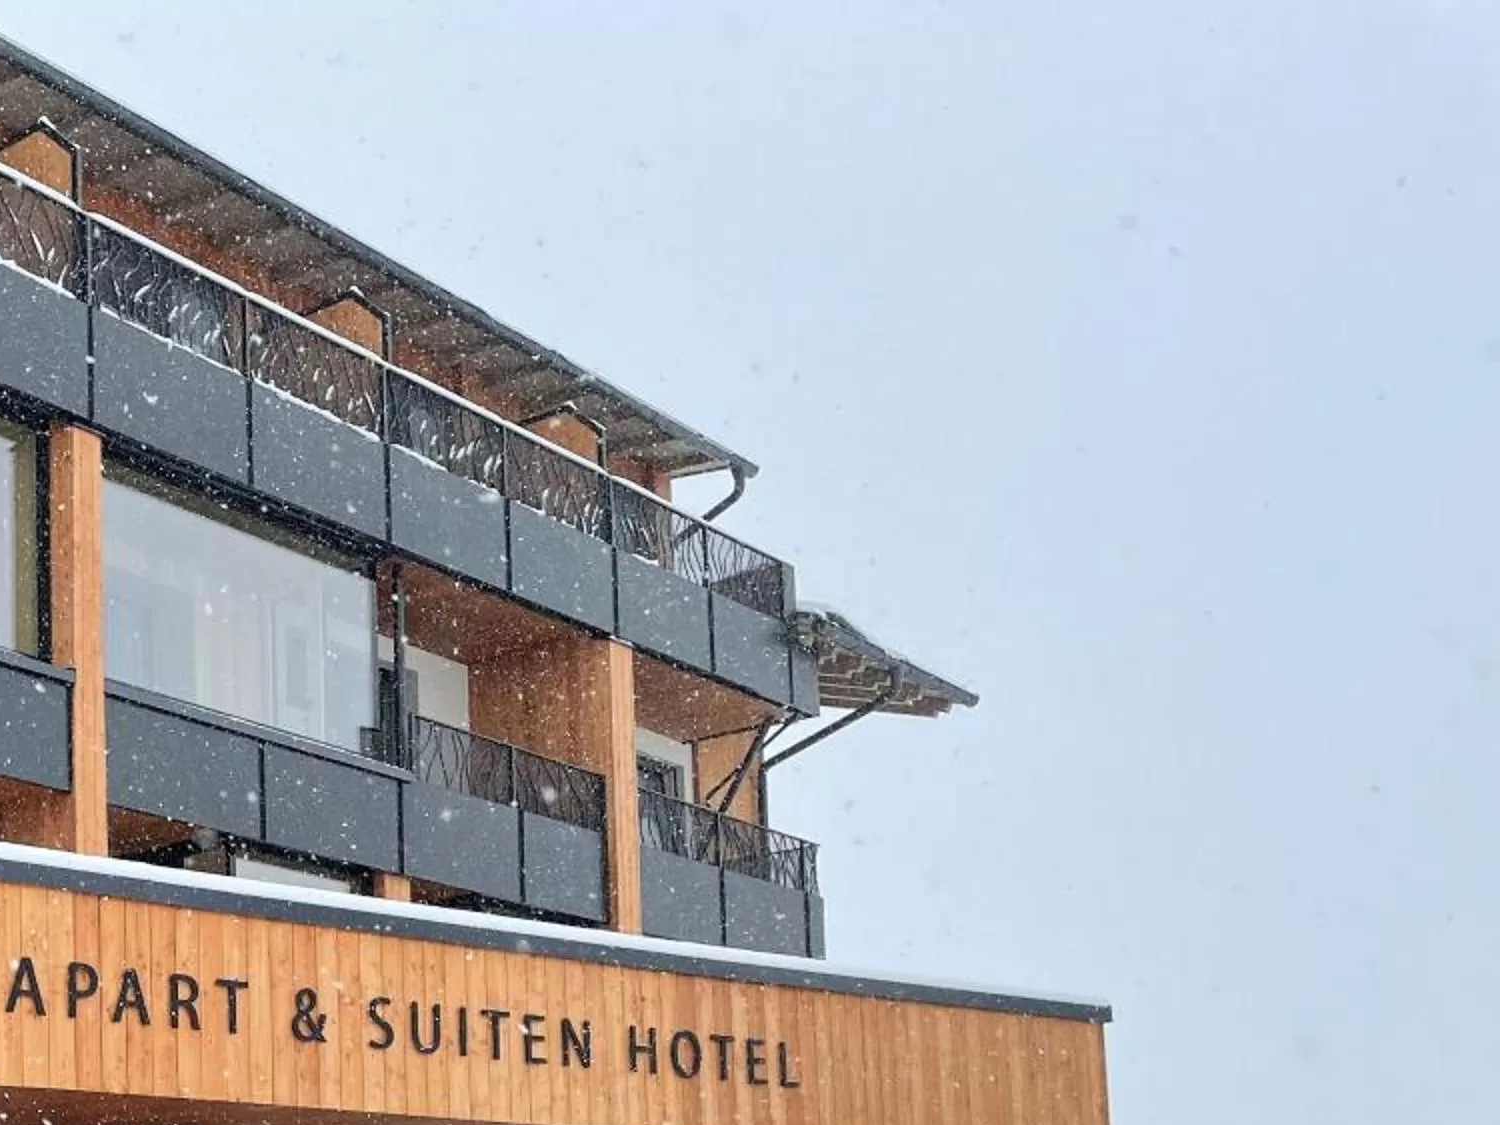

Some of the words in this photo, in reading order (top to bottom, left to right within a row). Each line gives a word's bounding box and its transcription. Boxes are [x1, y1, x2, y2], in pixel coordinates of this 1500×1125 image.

[5, 957, 249, 1035] APART
[291, 987, 327, 1043] &
[369, 996, 592, 1069] SUITEN
[628, 1024, 800, 1089] HOTEL
